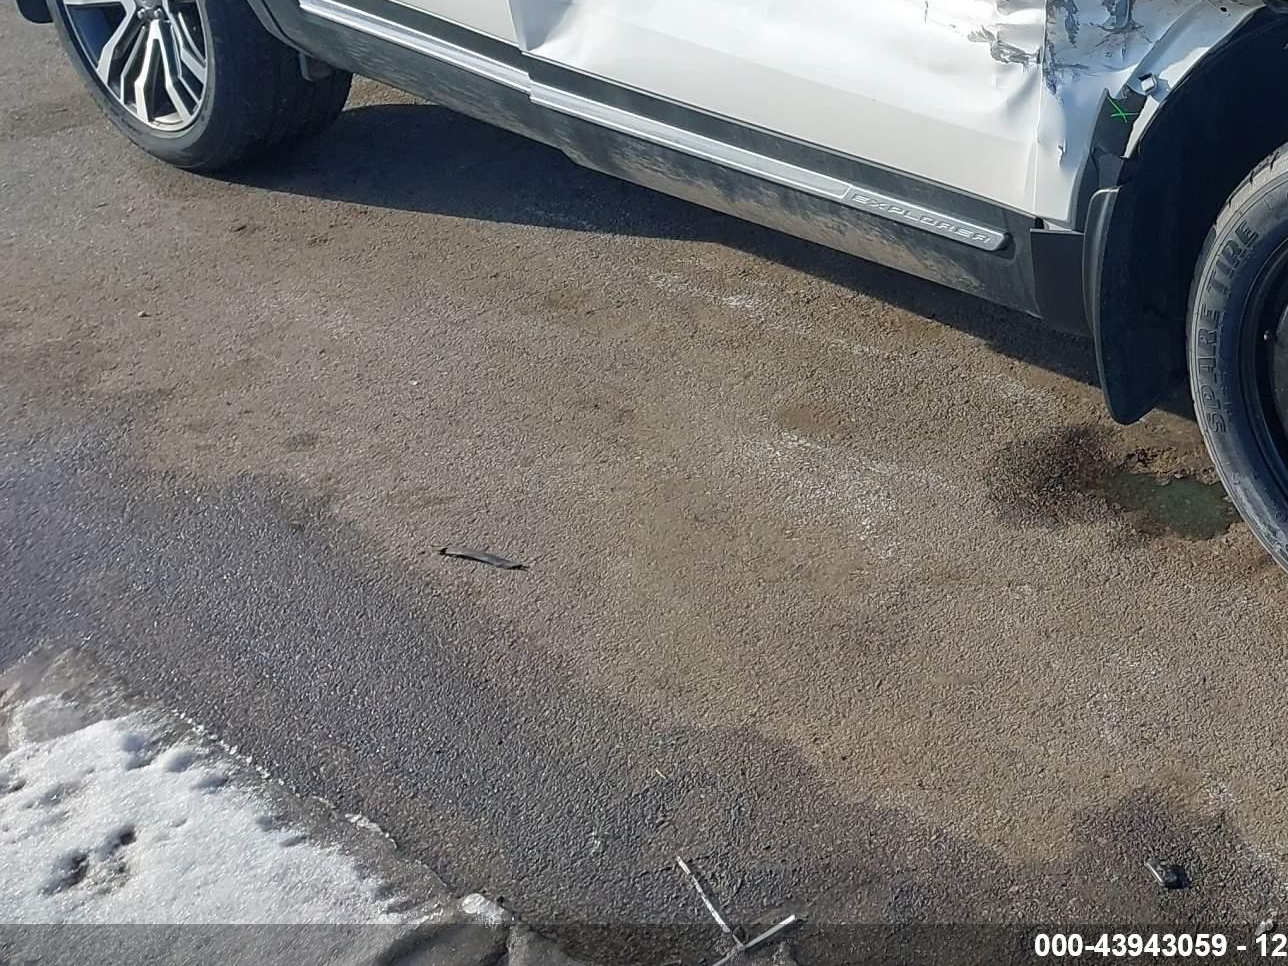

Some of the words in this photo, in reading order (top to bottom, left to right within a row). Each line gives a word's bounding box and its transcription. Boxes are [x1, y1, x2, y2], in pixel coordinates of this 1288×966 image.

[852, 192, 992, 245] EXPLORER
[1206, 218, 1259, 298] TIRE
[1197, 303, 1228, 435] SPARE
